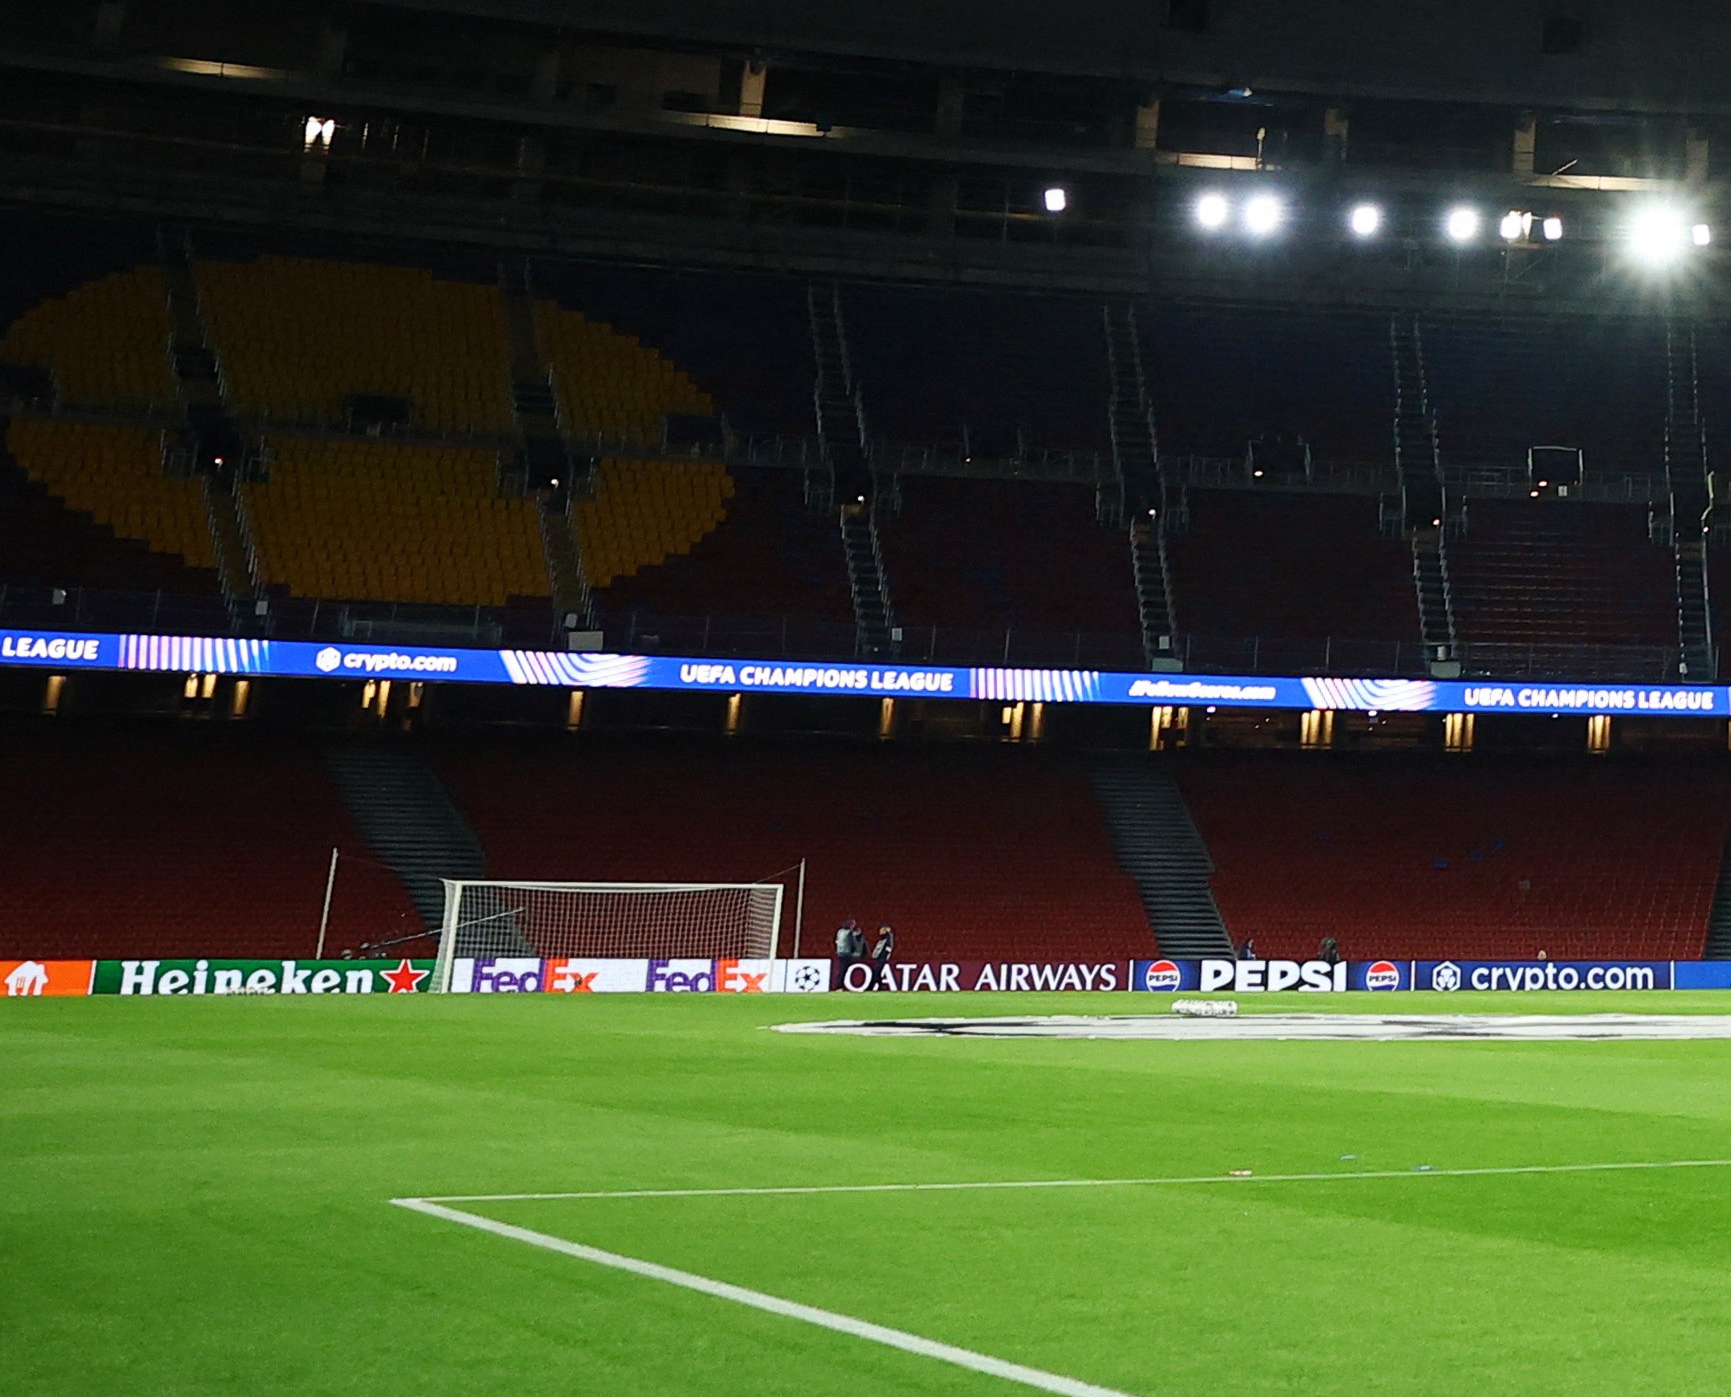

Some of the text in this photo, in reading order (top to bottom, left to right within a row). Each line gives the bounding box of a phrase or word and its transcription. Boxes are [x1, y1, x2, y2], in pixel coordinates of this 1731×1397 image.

[1, 636, 99, 660] LEAGUE
[344, 653, 457, 674] crypto.com
[680, 664, 954, 691] UEFA CHAMPIONS LEAGUE
[1464, 687, 1713, 710] UEFA CHAMPIONS LEAGUE
[120, 959, 375, 994] Heineken
[471, 957, 599, 992] FedEx
[645, 958, 767, 992] FedEx
[843, 963, 1117, 992] QATAR AIRWAYS
[1149, 974, 1177, 982] PEPSI
[1200, 959, 1347, 992] PEPSI
[1471, 964, 1654, 992] crypto.com
